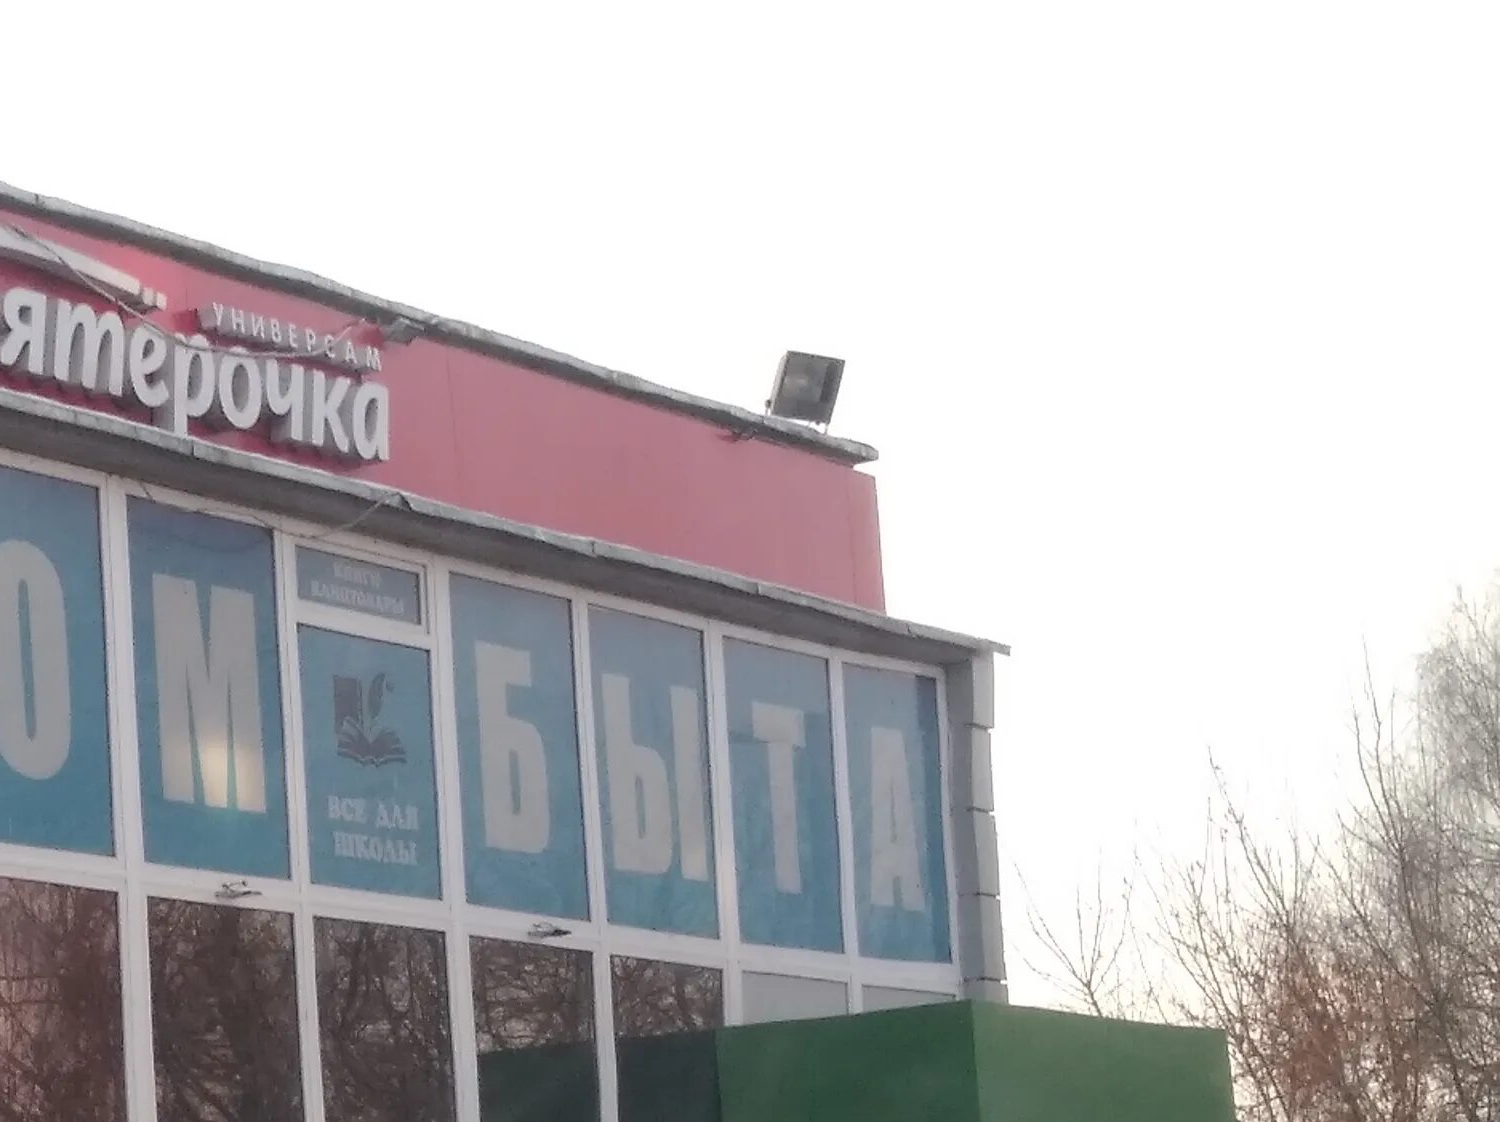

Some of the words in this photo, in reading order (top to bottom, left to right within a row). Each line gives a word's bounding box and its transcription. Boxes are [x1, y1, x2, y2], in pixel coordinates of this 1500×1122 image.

[211, 302, 383, 372] УНИВЕРСАМ
[474, 641, 926, 912] БЫТА
[332, 831, 418, 865] ШКОЛЫ
